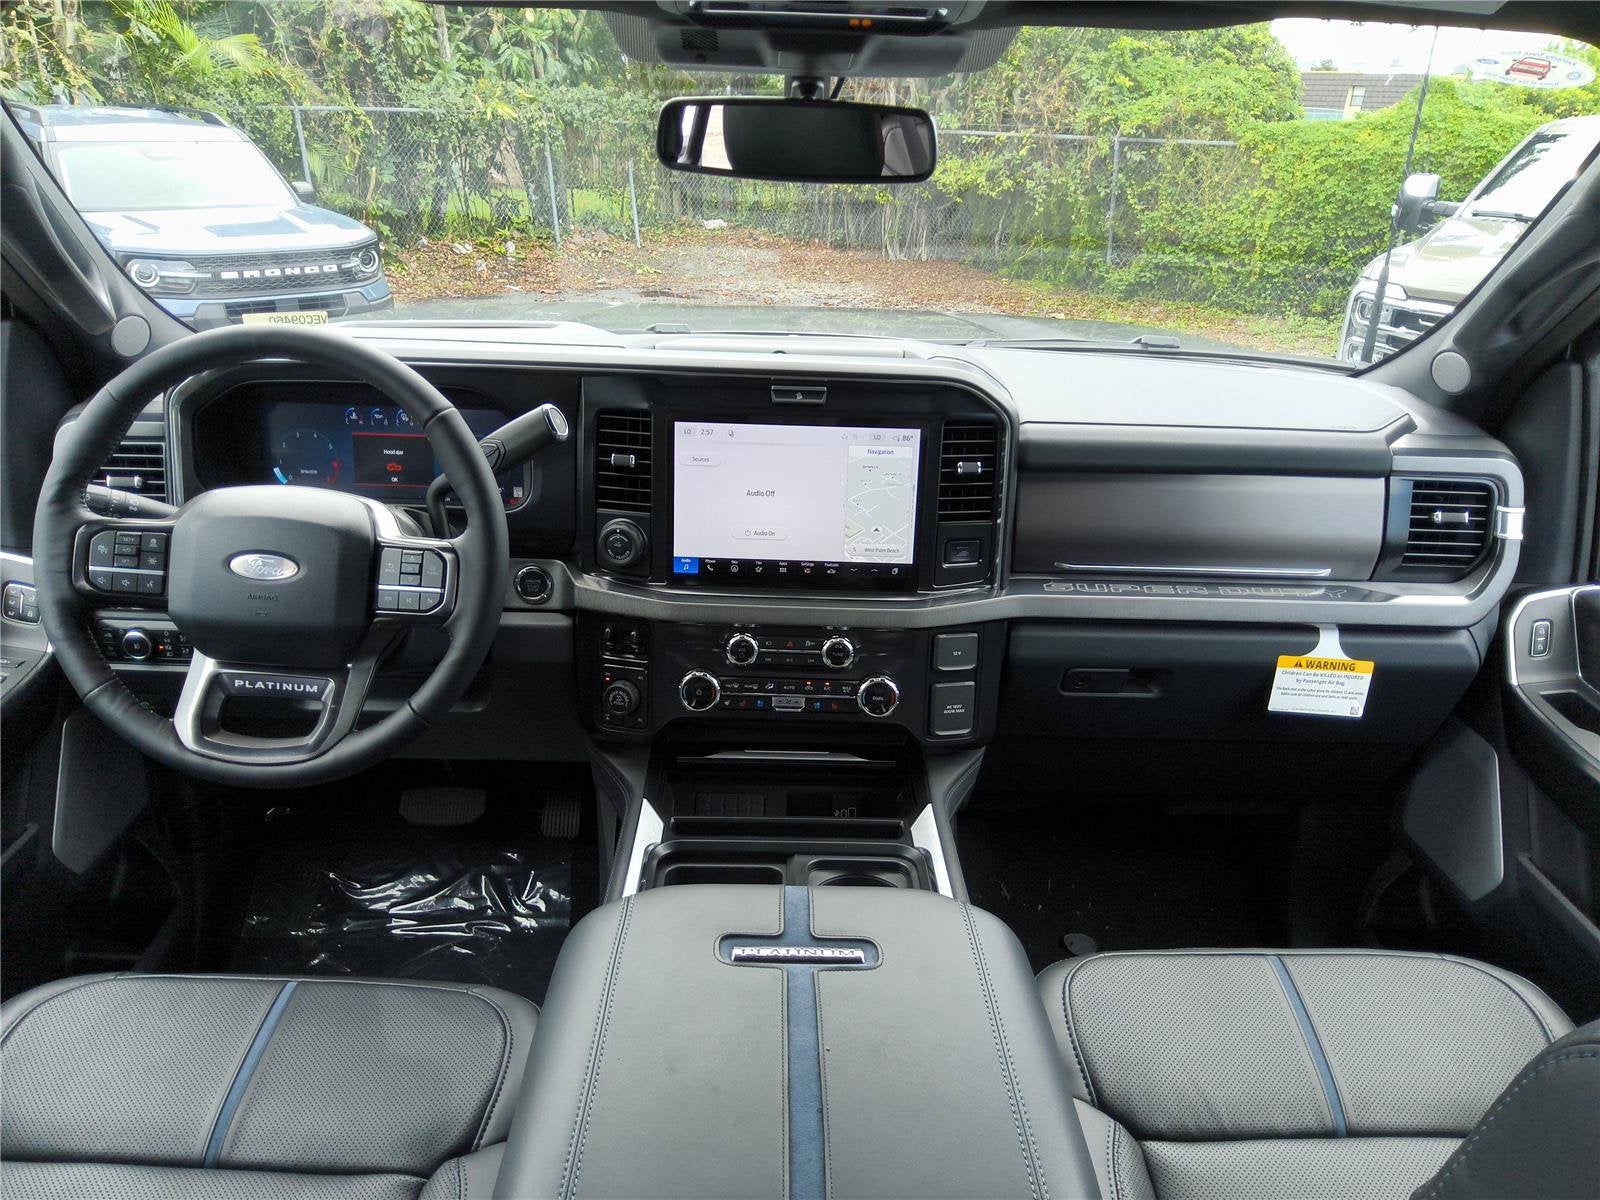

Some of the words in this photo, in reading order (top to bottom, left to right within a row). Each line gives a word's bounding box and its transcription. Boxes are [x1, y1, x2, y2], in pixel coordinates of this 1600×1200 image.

[220, 264, 338, 279] BRONCO
[1043, 582, 1209, 594] SUPER
[1217, 586, 1348, 598] DUTY
[1306, 660, 1356, 672] WARNING
[234, 680, 318, 692] PLATINUM
